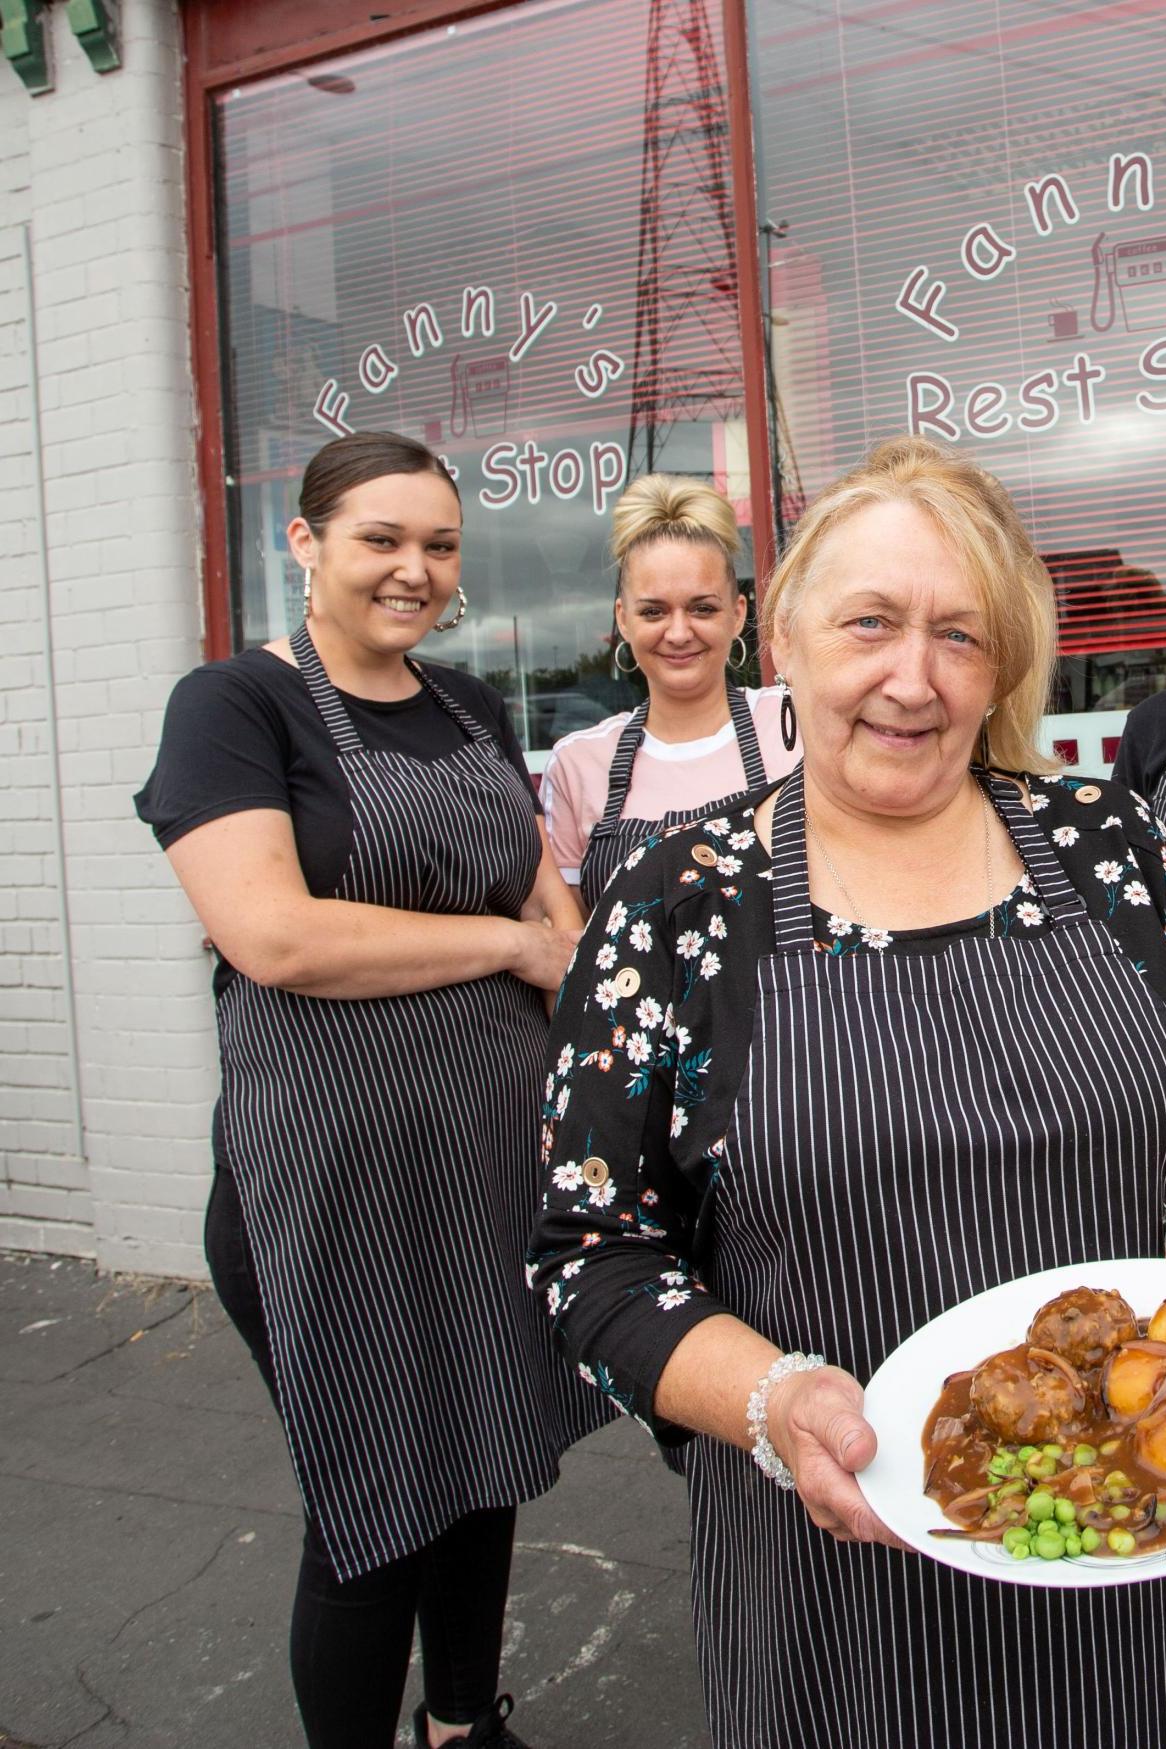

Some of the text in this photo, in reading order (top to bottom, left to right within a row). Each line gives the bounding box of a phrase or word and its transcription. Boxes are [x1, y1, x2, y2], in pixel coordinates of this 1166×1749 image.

[312, 286, 624, 436] Fanny's
[906, 351, 1106, 441] Rest
[479, 438, 626, 516] Stop
